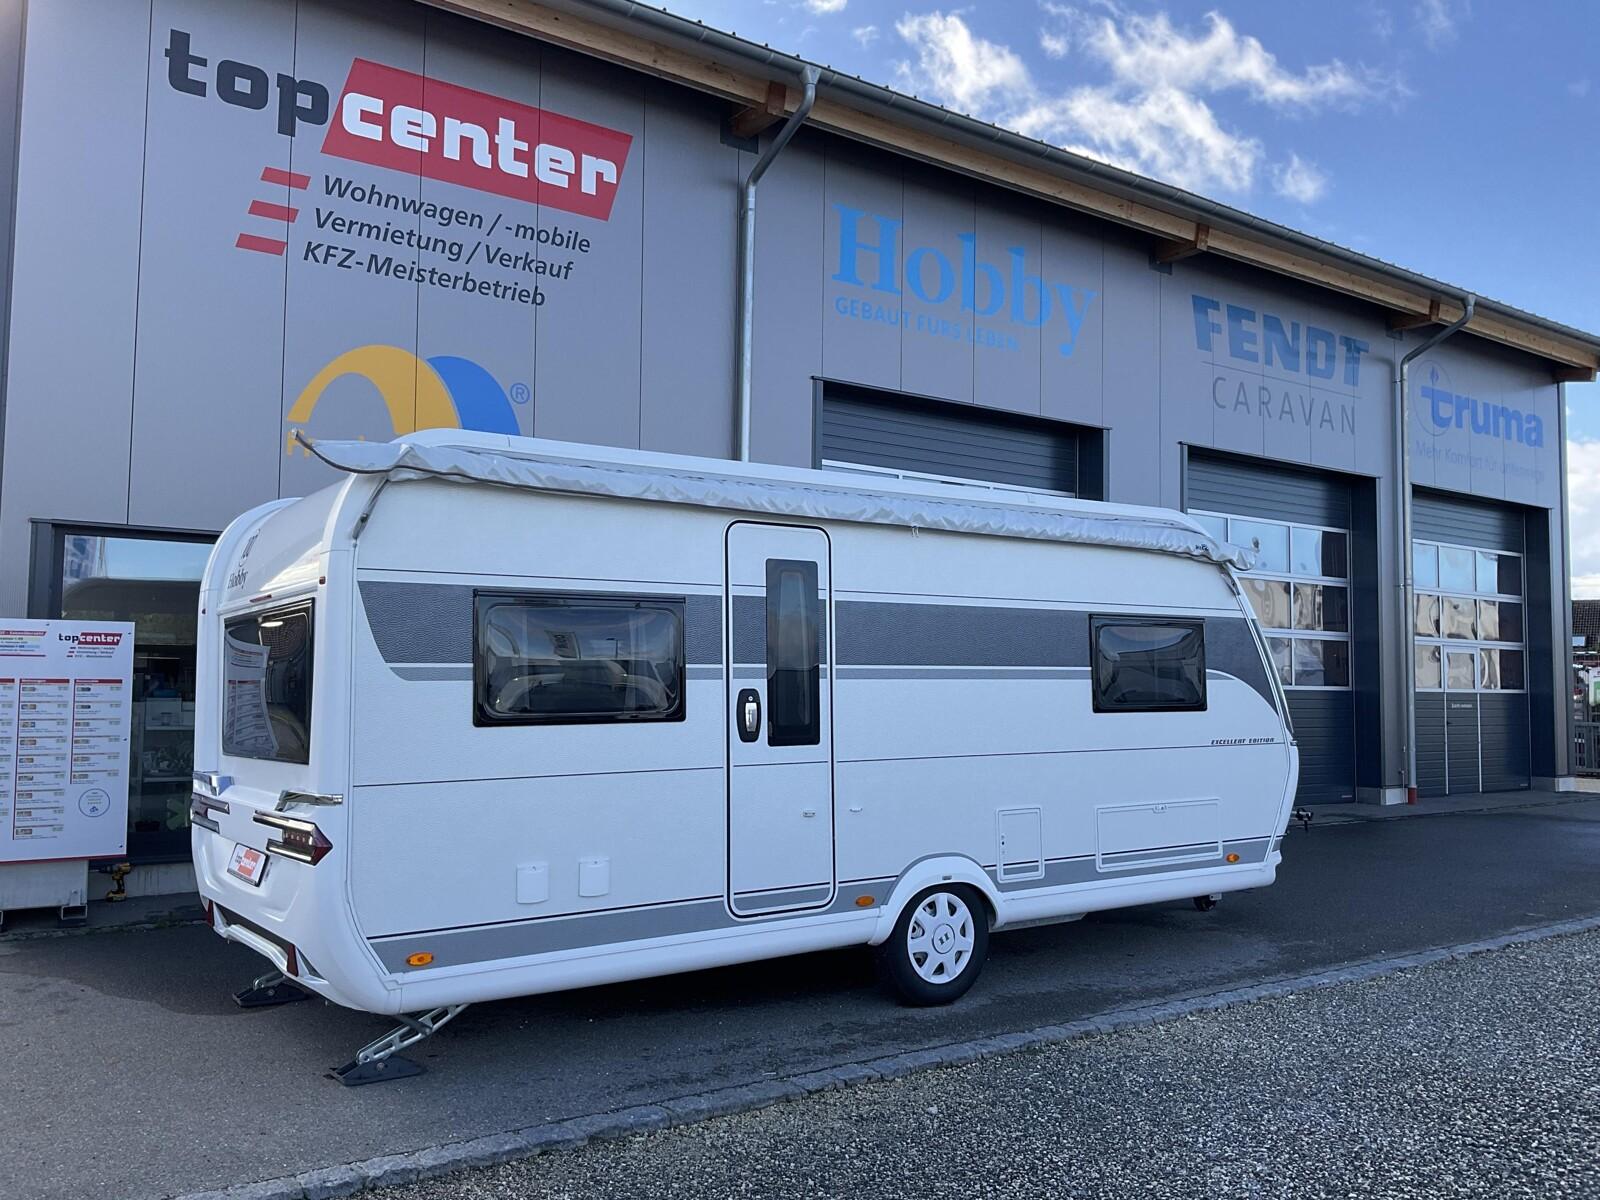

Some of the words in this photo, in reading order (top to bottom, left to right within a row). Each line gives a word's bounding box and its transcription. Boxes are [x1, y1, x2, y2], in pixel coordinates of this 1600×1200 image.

[165, 29, 618, 197] topcenter
[303, 241, 547, 307] KFZ-Meisterbetrieb
[832, 203, 1097, 358] Hobby
[835, 296, 910, 329] GEBAUT
[1192, 294, 1370, 388] FENDT
[1212, 376, 1356, 436] CARAVAN
[1421, 385, 1544, 448] truma
[1415, 440, 1441, 462] Mehr
[228, 568, 248, 589] Hobby
[58, 632, 121, 645] topcenter
